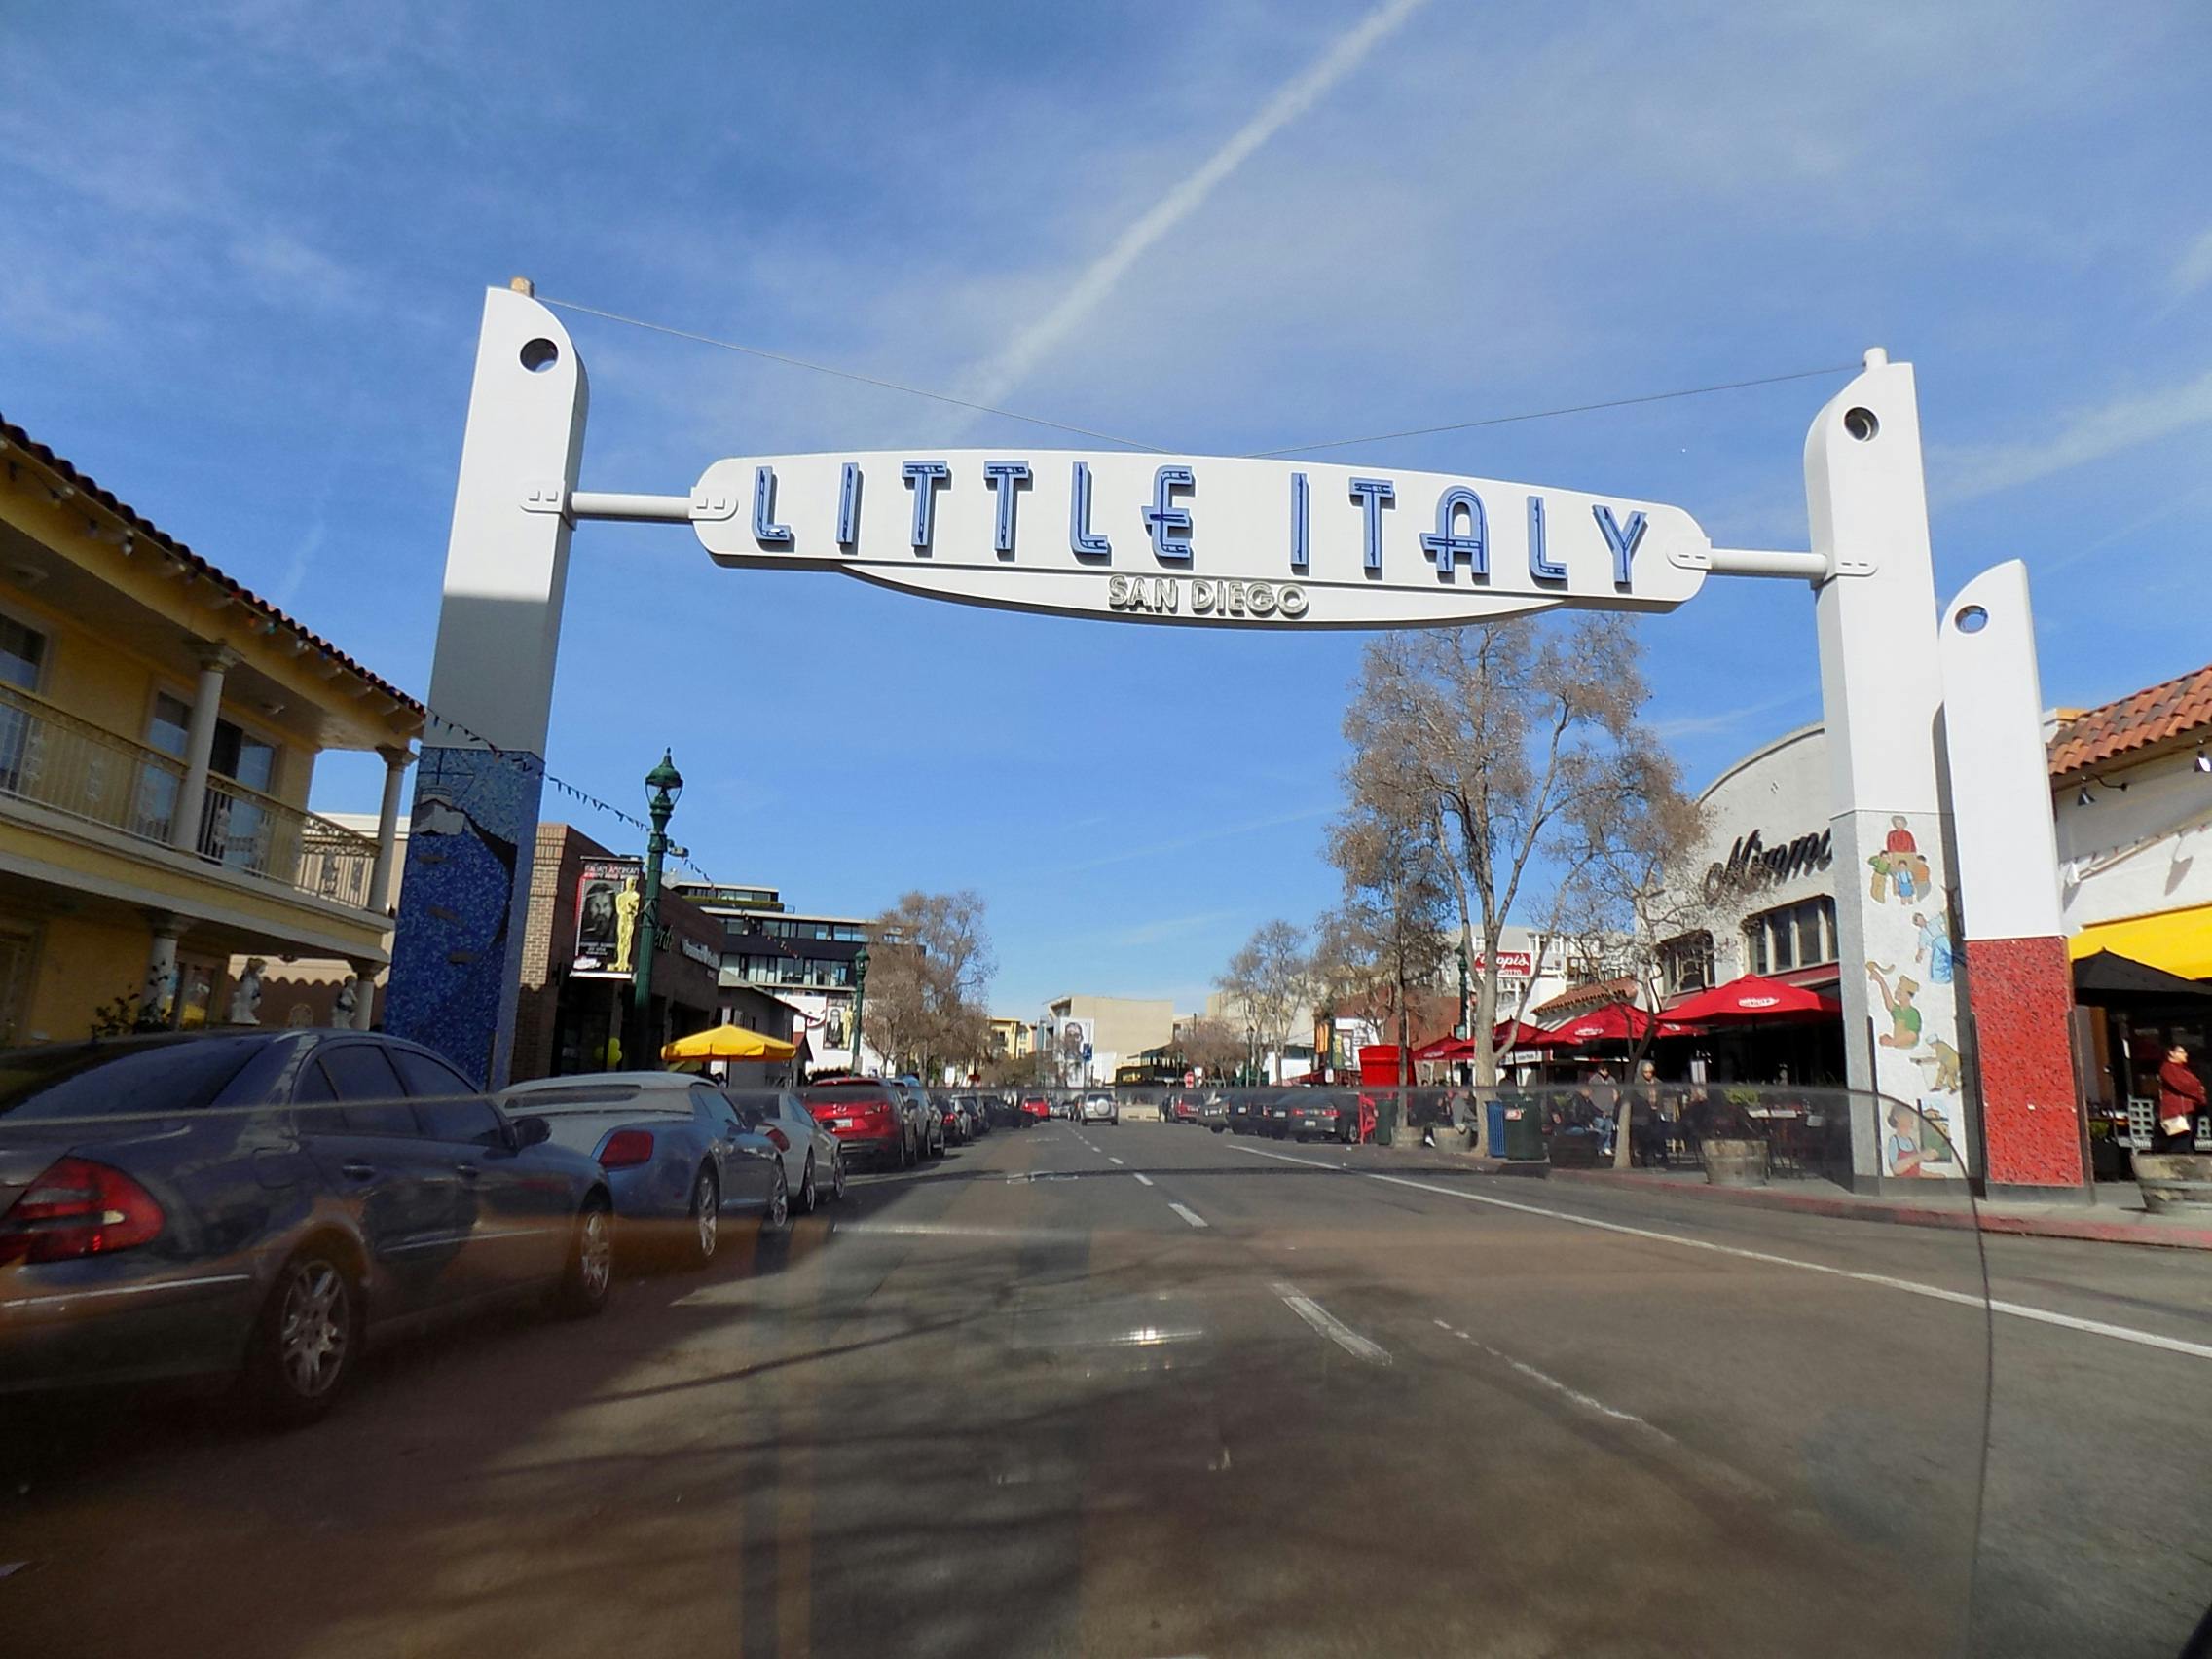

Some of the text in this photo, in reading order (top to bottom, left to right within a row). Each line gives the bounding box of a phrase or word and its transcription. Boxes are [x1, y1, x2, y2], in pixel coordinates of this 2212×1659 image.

[751, 460, 1648, 583] LITTLE ITALY
[1109, 573, 1309, 617] SAN DIEGO
